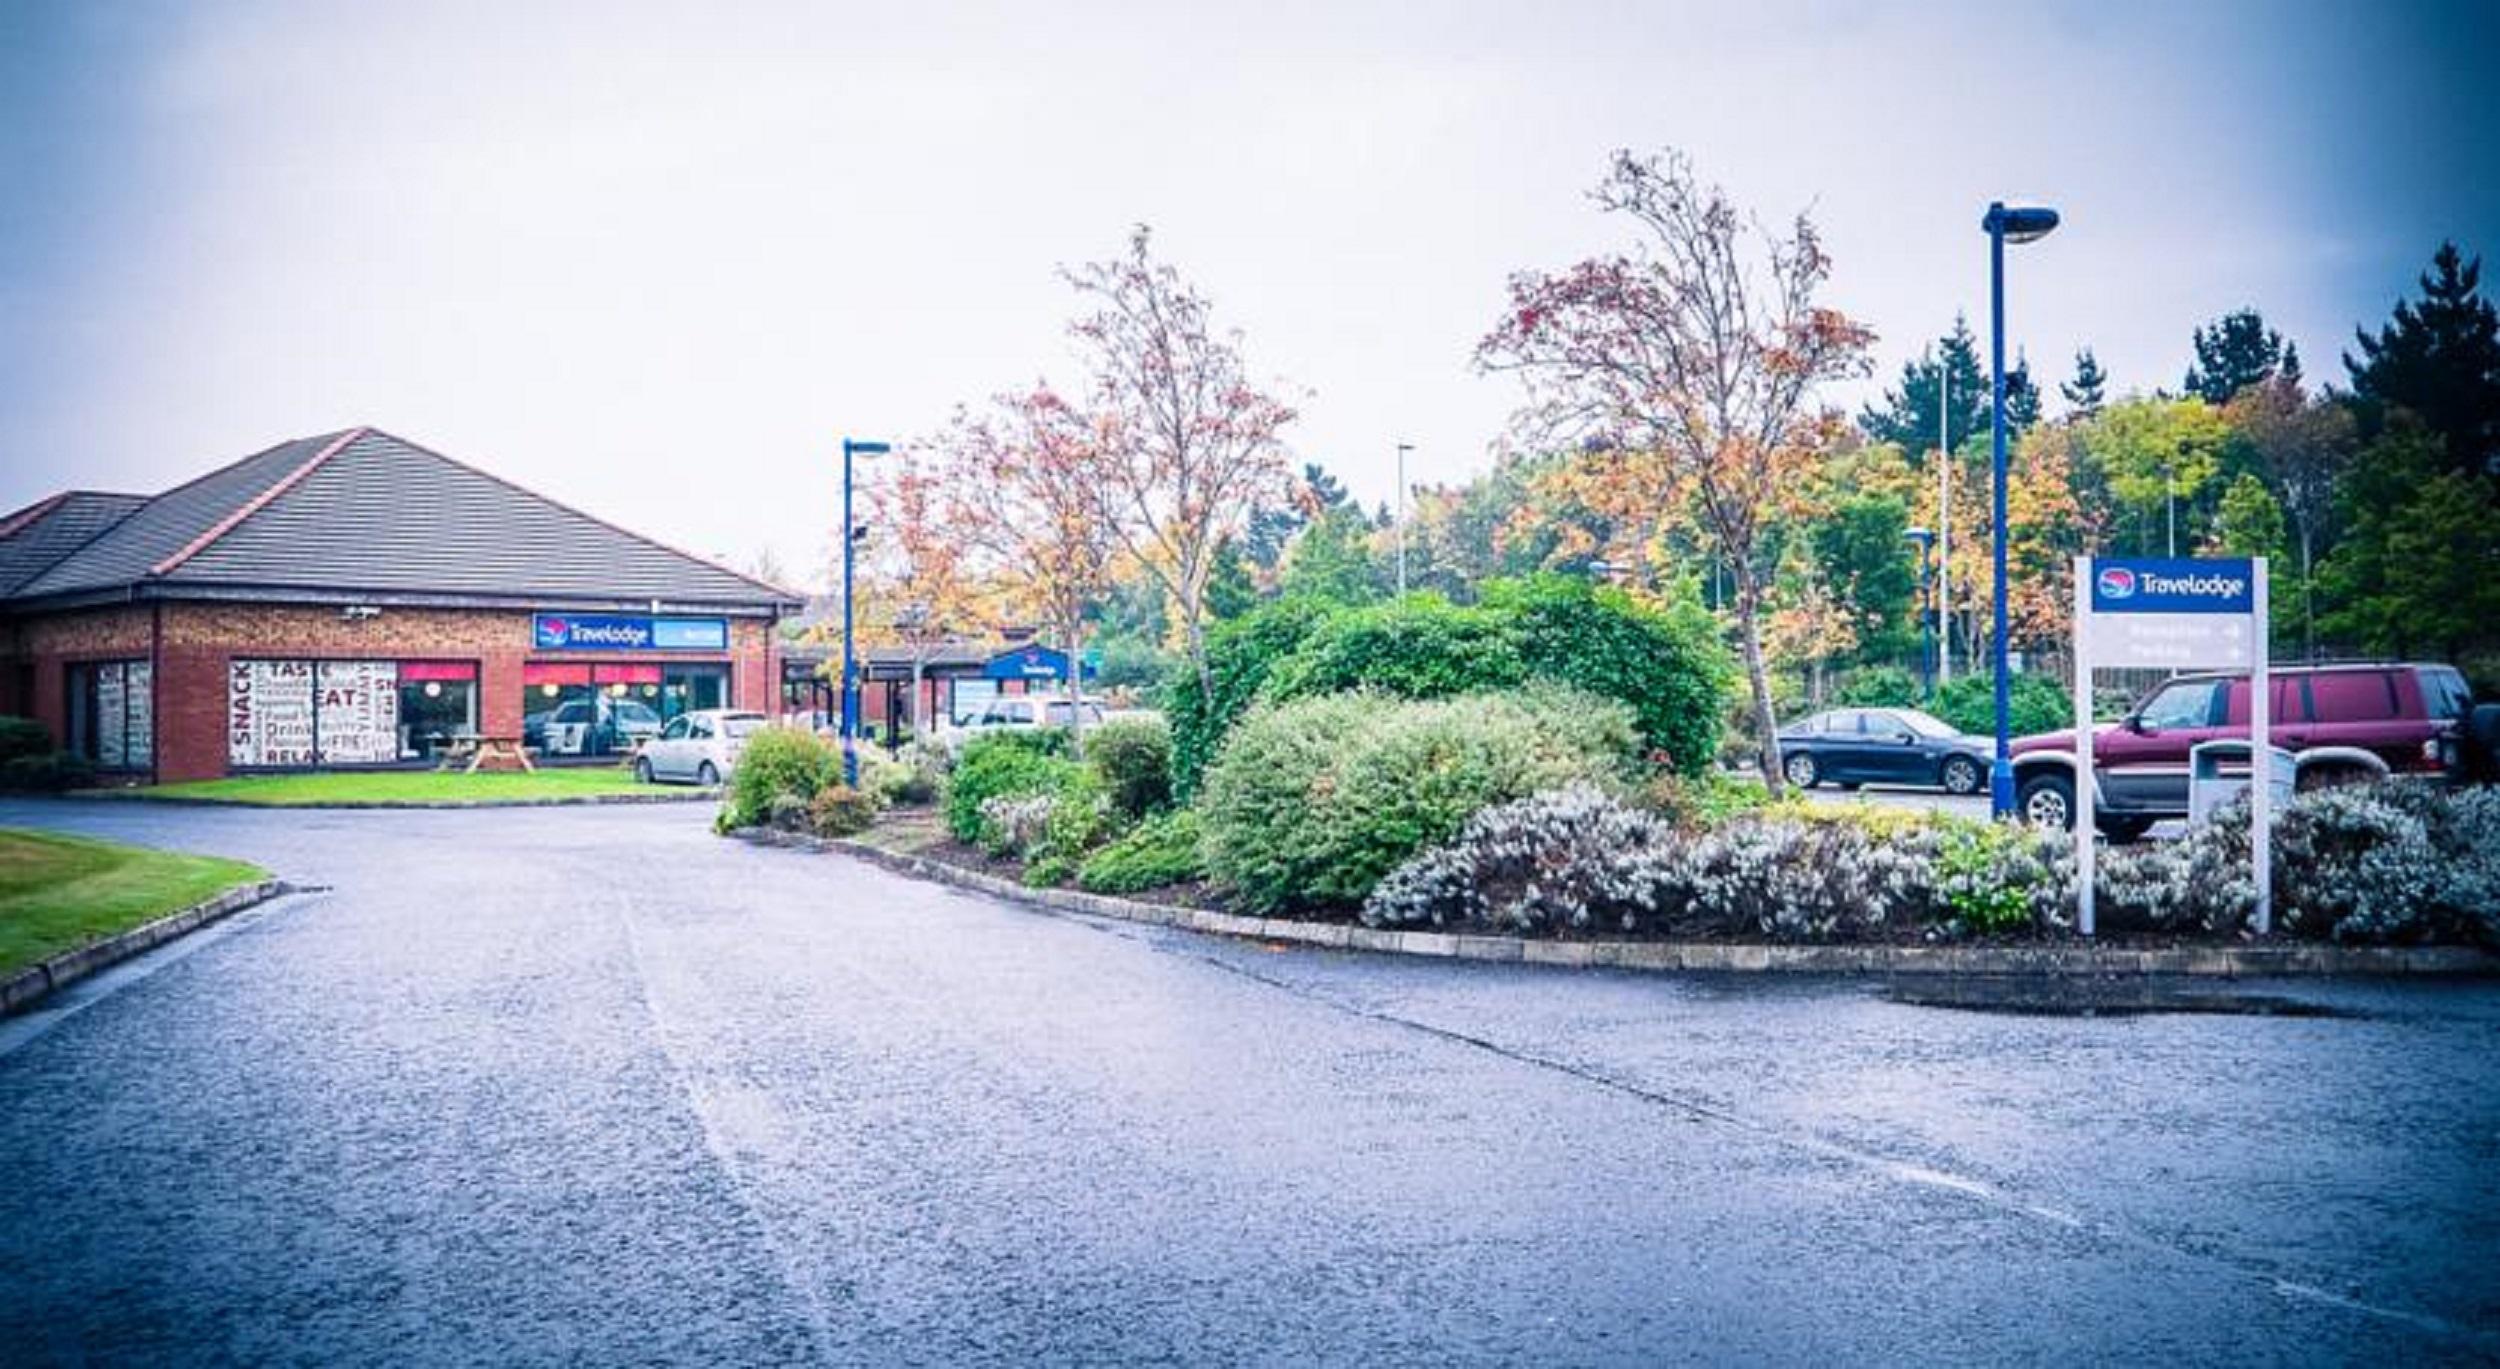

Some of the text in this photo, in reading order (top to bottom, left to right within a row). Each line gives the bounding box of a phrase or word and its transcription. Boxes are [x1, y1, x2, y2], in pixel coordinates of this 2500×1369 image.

[2140, 573, 2245, 599] Travelodge
[570, 623, 648, 646] Travelodge
[269, 663, 332, 677] TASE
[233, 662, 251, 745] SNACK
[316, 689, 356, 707] EAT
